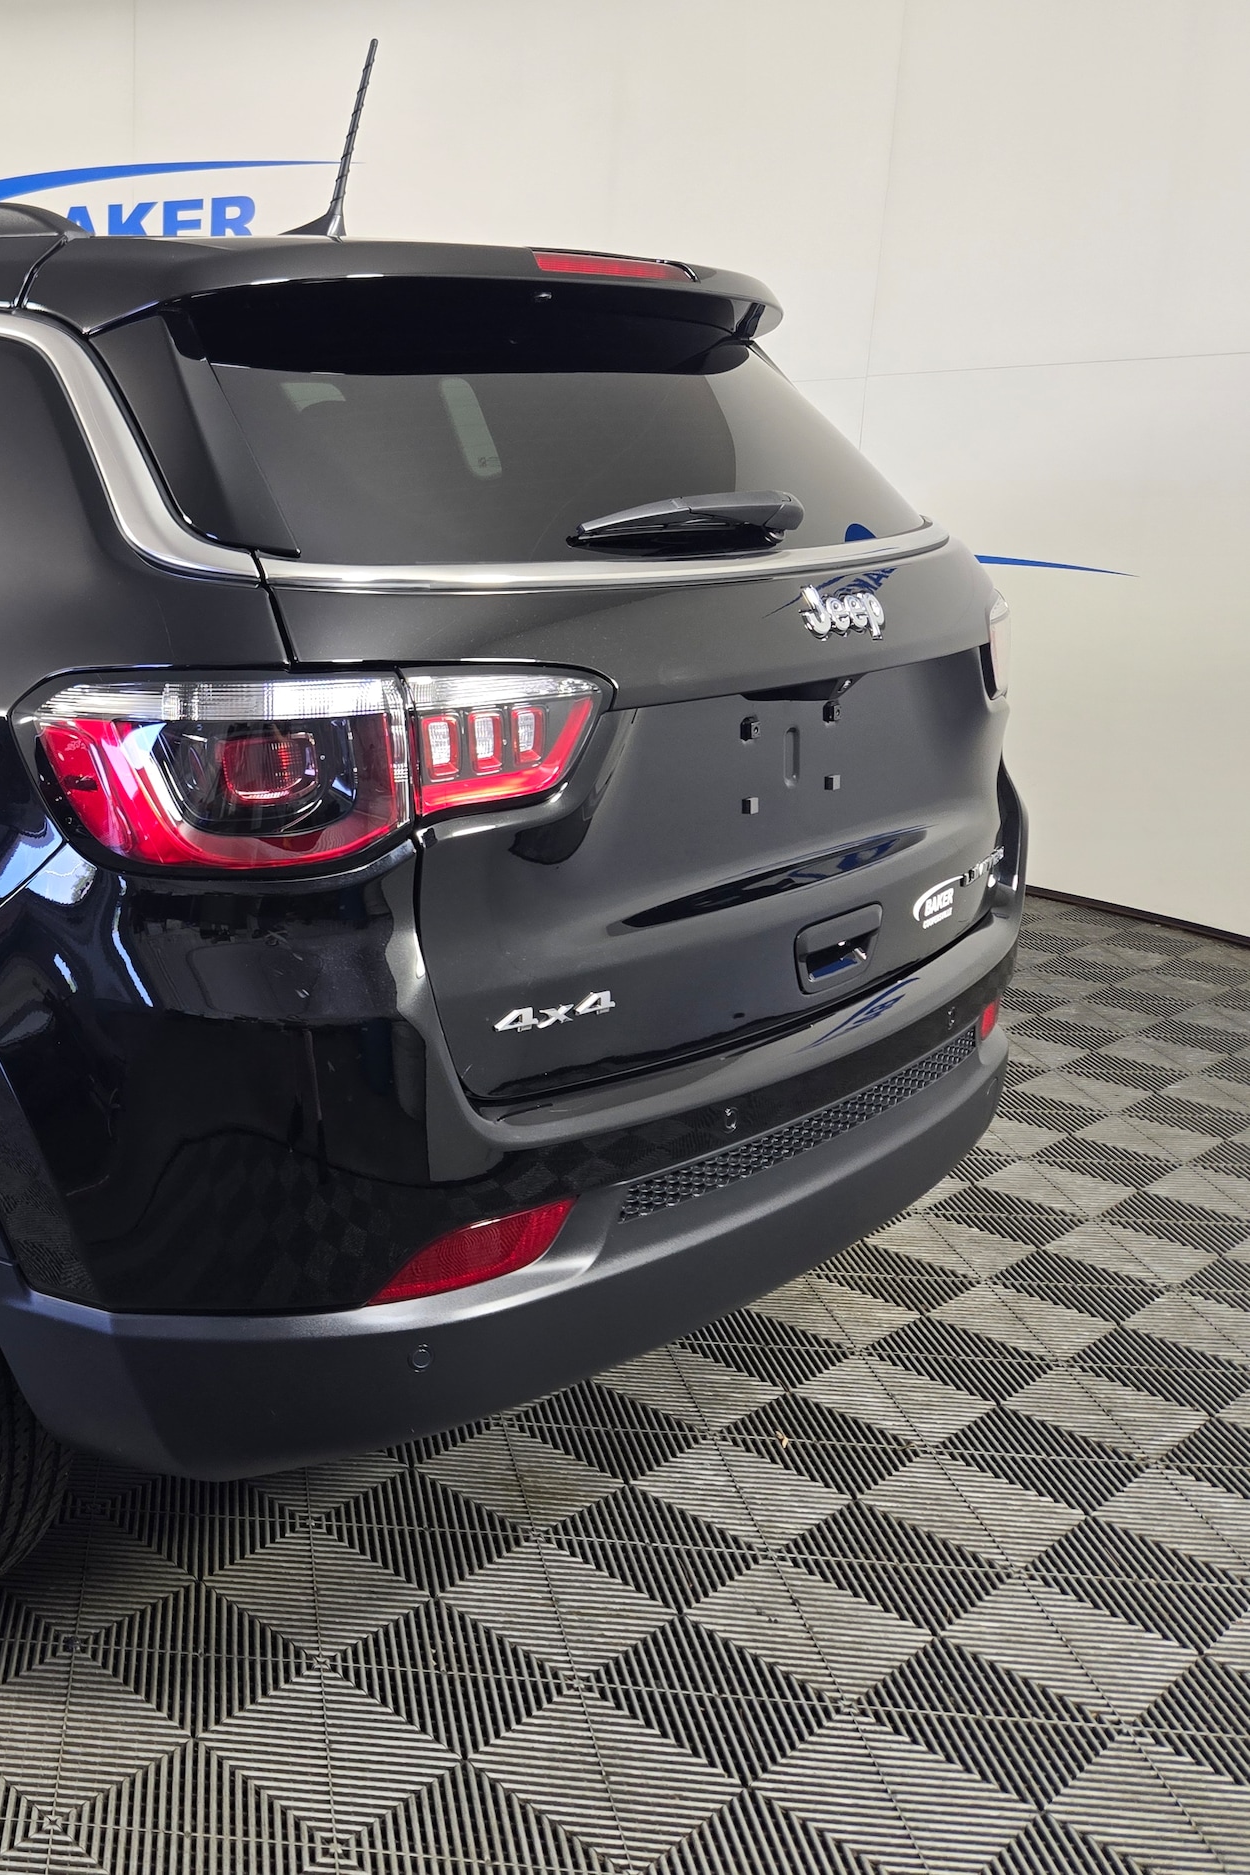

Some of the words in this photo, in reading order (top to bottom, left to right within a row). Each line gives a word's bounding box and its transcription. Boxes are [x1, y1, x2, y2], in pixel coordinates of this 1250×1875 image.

[65, 194, 256, 237] AKER
[799, 584, 886, 642] Jeep
[924, 887, 955, 917] BAKER
[492, 990, 616, 1033] 4x4
